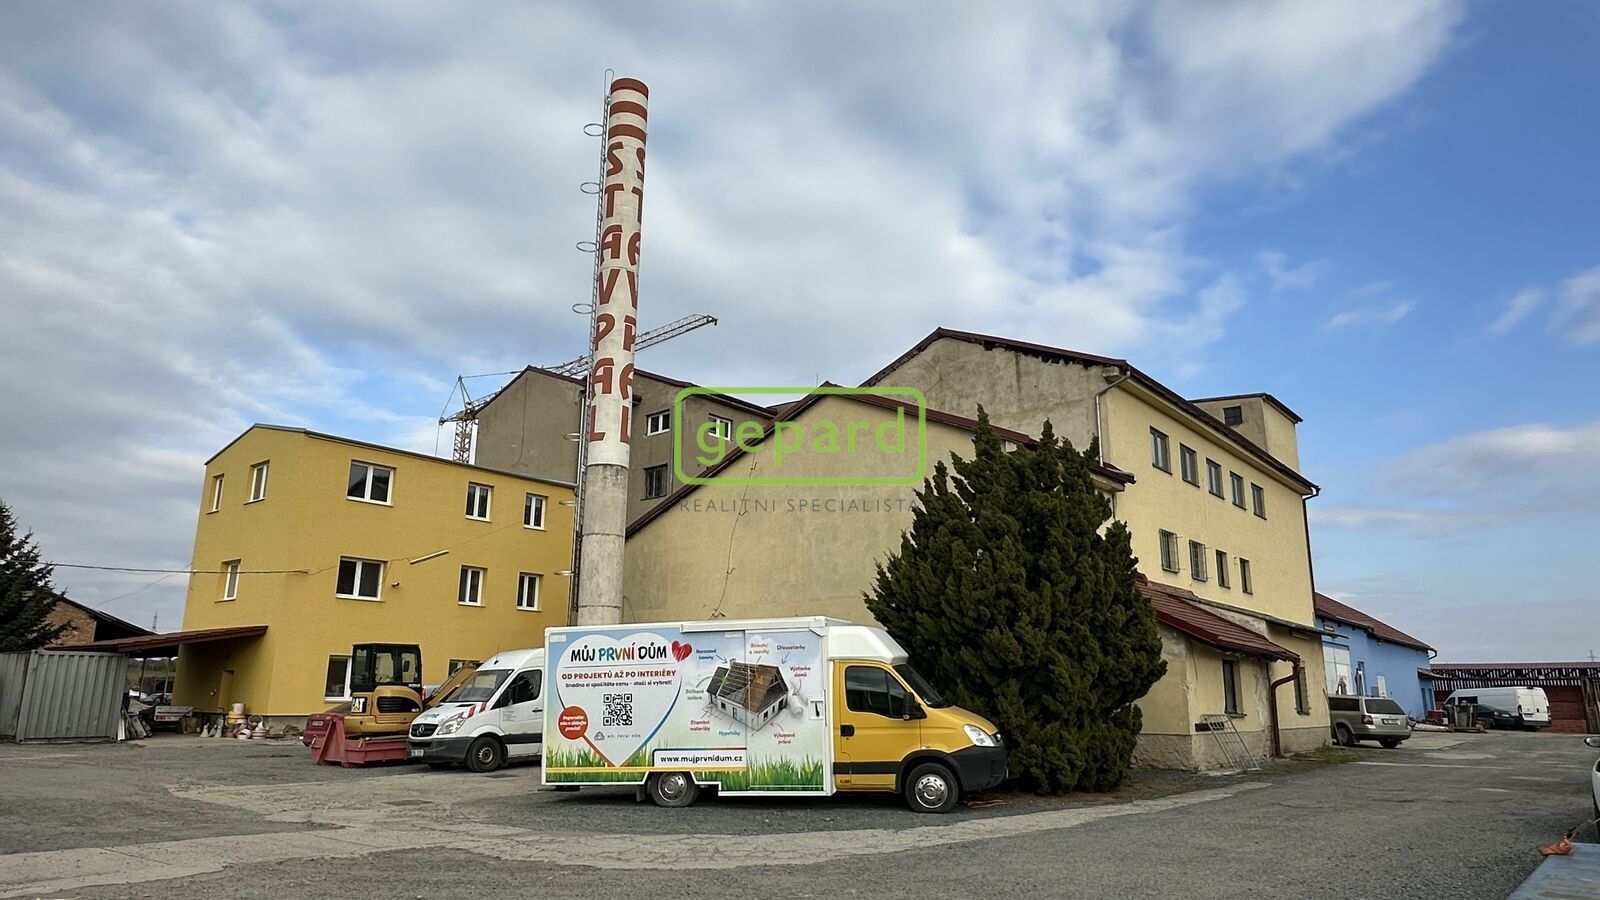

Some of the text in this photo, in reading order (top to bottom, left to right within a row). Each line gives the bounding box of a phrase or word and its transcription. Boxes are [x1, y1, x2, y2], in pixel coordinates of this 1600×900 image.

[570, 642, 667, 662] MŮJ PRVNÍ DŮM
[573, 670, 613, 680] PROJEKTŮ
[614, 669, 625, 679] AŽ
[637, 668, 677, 678] INTERIÉRY
[660, 755, 743, 764] www.mujprvnidum.cz
